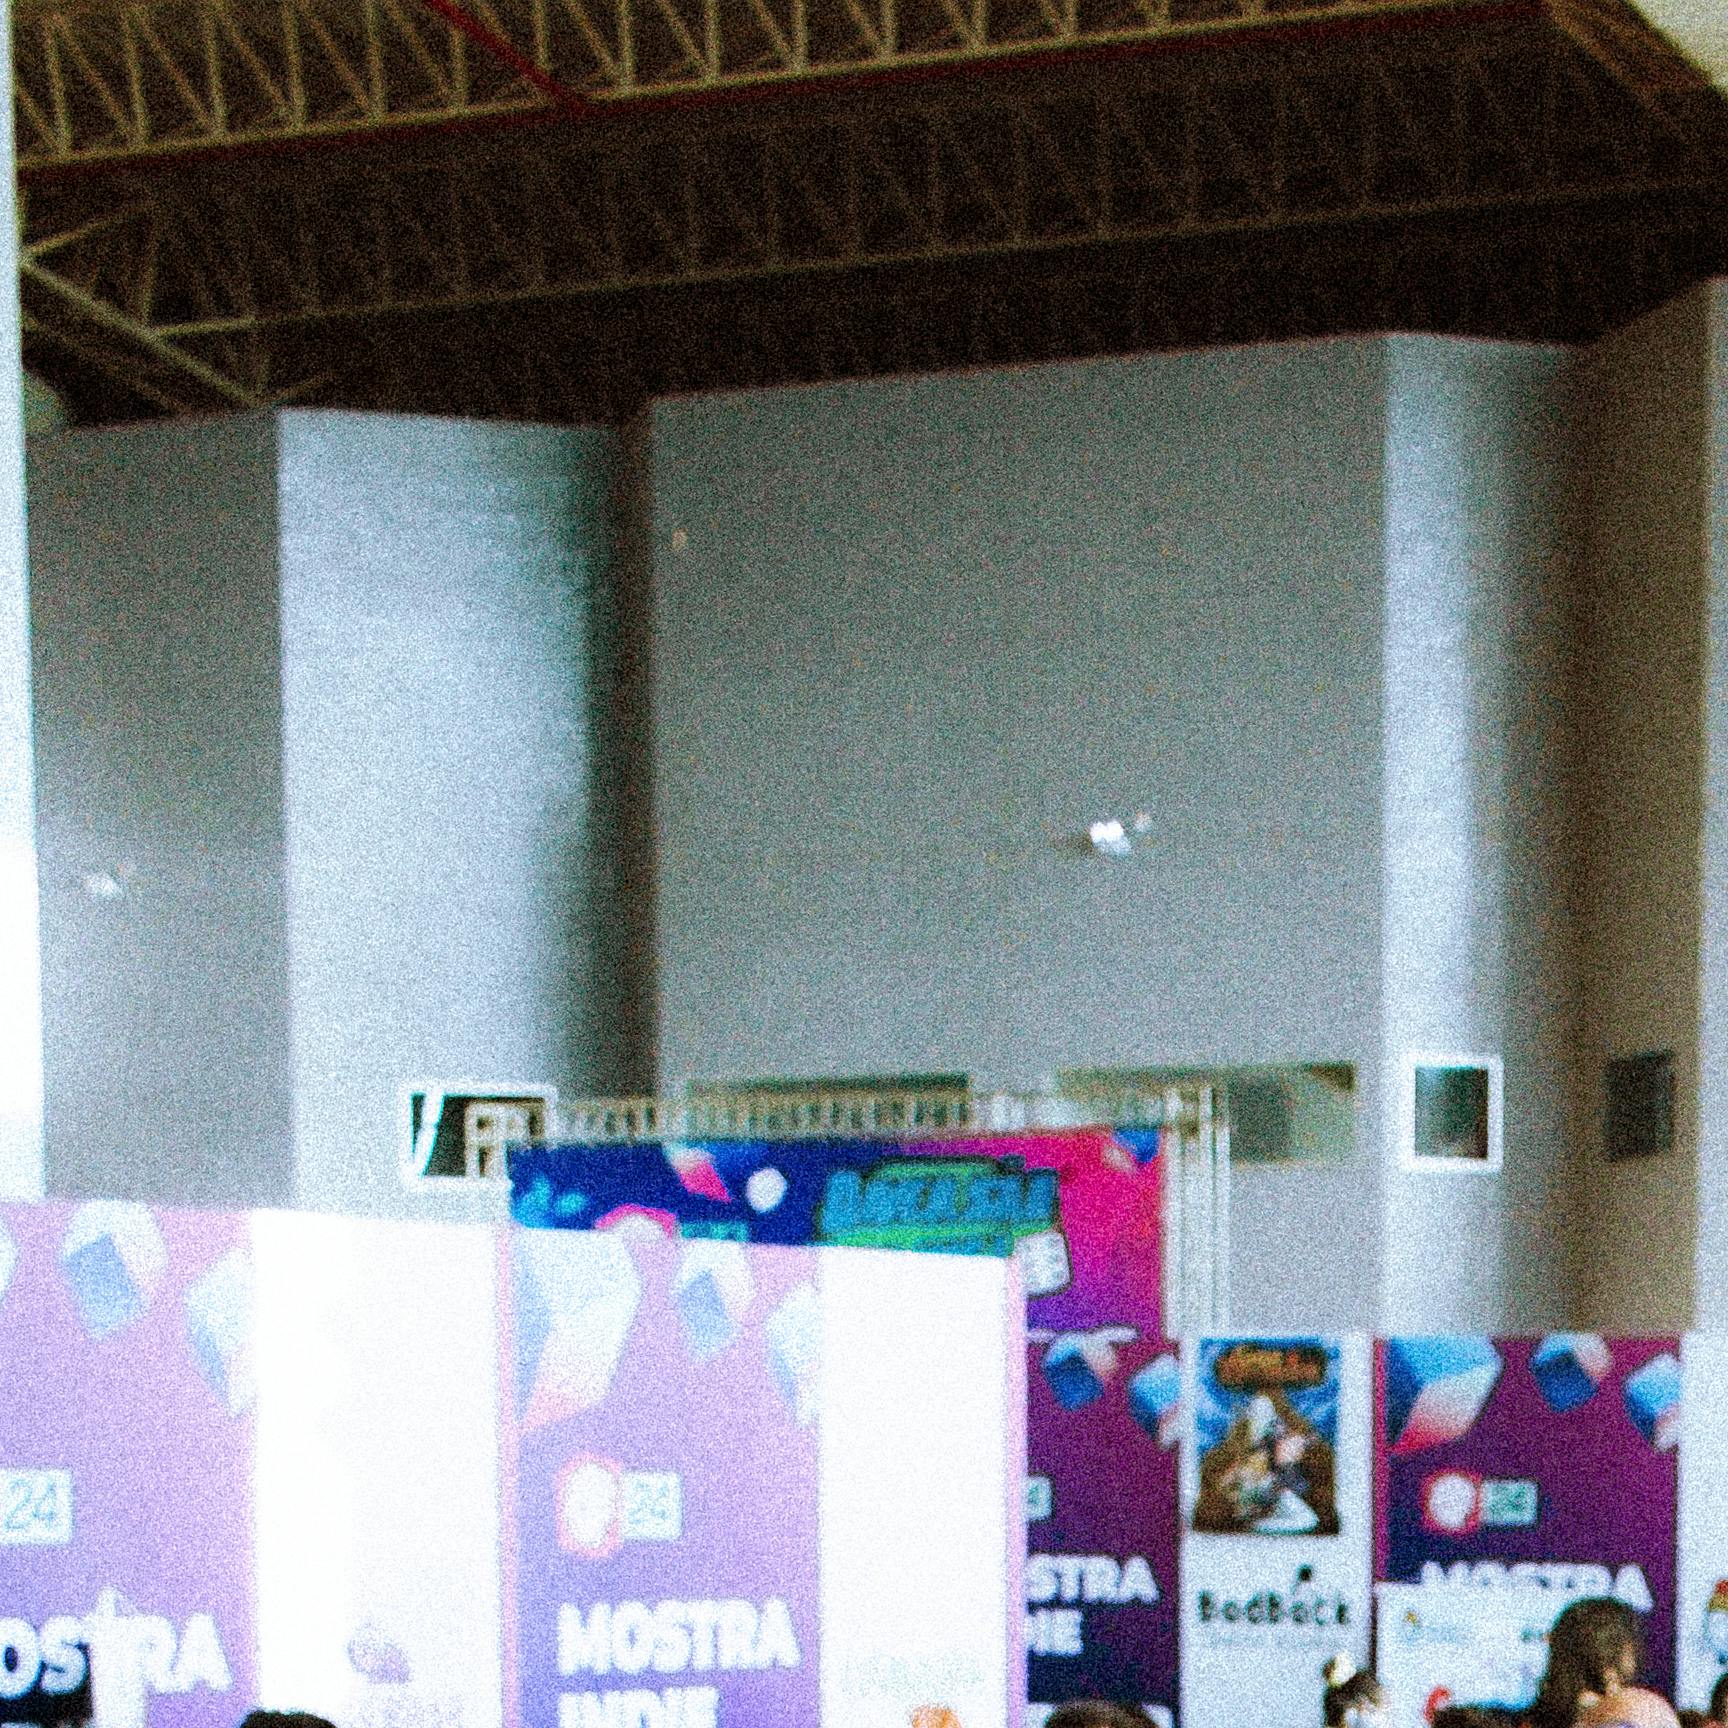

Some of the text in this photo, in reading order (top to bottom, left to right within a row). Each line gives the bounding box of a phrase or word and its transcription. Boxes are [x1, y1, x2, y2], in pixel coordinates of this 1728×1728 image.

[3, 1469, 58, 1530] 24
[0, 1610, 230, 1698] OSRA
[559, 1601, 801, 1673] MOSTRA
